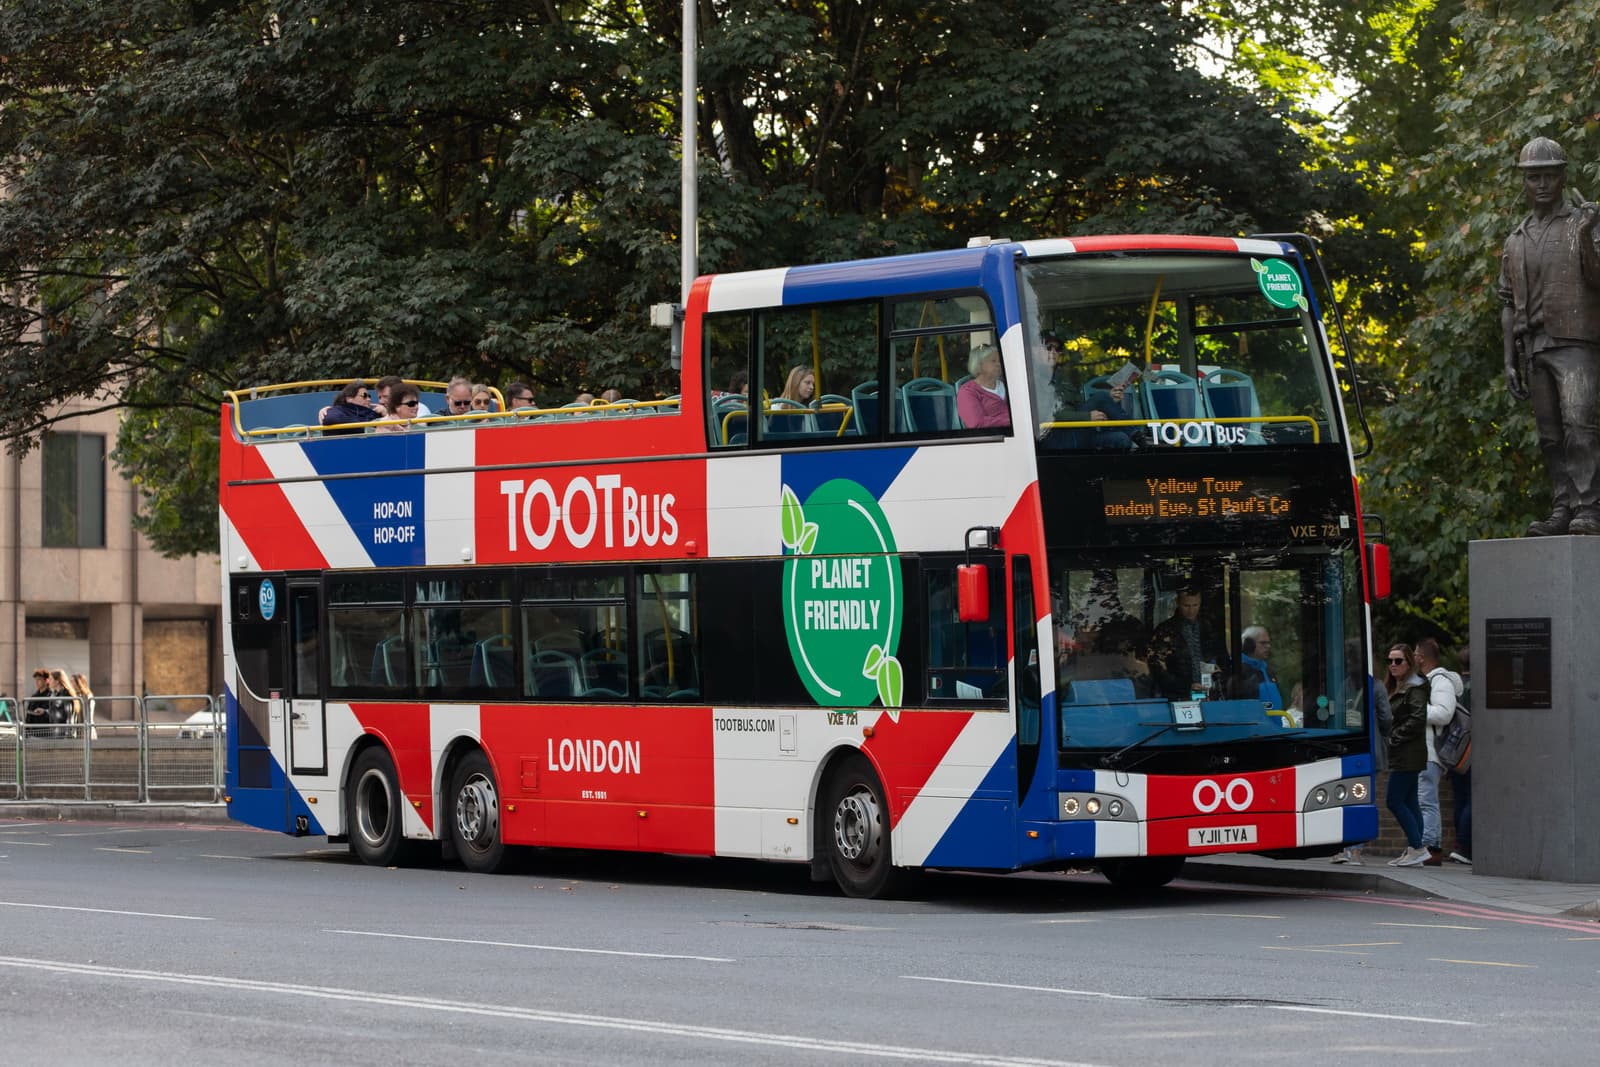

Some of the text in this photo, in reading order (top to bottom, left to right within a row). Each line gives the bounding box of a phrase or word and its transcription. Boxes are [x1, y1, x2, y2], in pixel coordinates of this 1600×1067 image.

[1266, 283, 1296, 291] FRIENDLY
[1145, 477, 1244, 496] Yellow Tour
[373, 500, 412, 519] HOP-ON
[1198, 498, 1216, 516] St
[1221, 496, 1265, 515] Paul's
[374, 525, 416, 544] HOP-OFF
[1290, 523, 1341, 538] VXE 721
[811, 558, 872, 589] PLANET
[804, 600, 880, 630] FRIENDLY
[715, 718, 775, 732] TOOTBUS.COM
[827, 712, 859, 726] VXE 721
[547, 738, 641, 774] LONDON
[1198, 828, 1248, 844] YJ11 TVA
